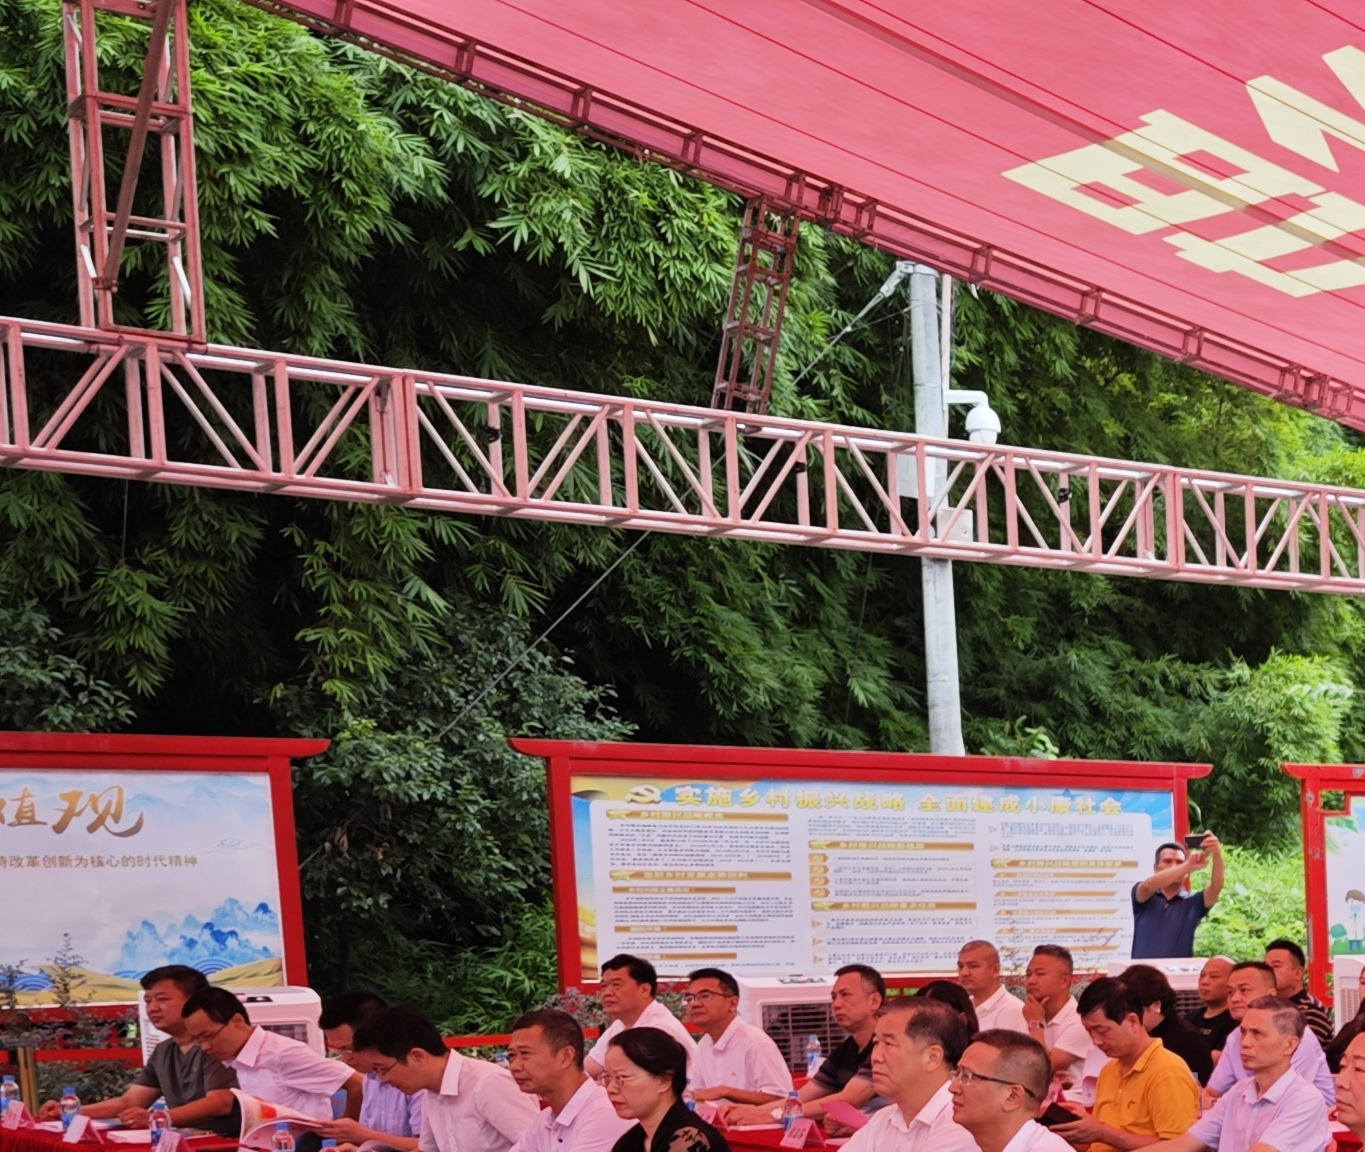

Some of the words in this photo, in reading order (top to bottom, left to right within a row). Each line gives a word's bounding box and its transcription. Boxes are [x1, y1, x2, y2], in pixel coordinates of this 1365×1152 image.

[674, 784, 906, 811] 实施乡村振兴战略
[917, 792, 1122, 815] 全面建成小康社会
